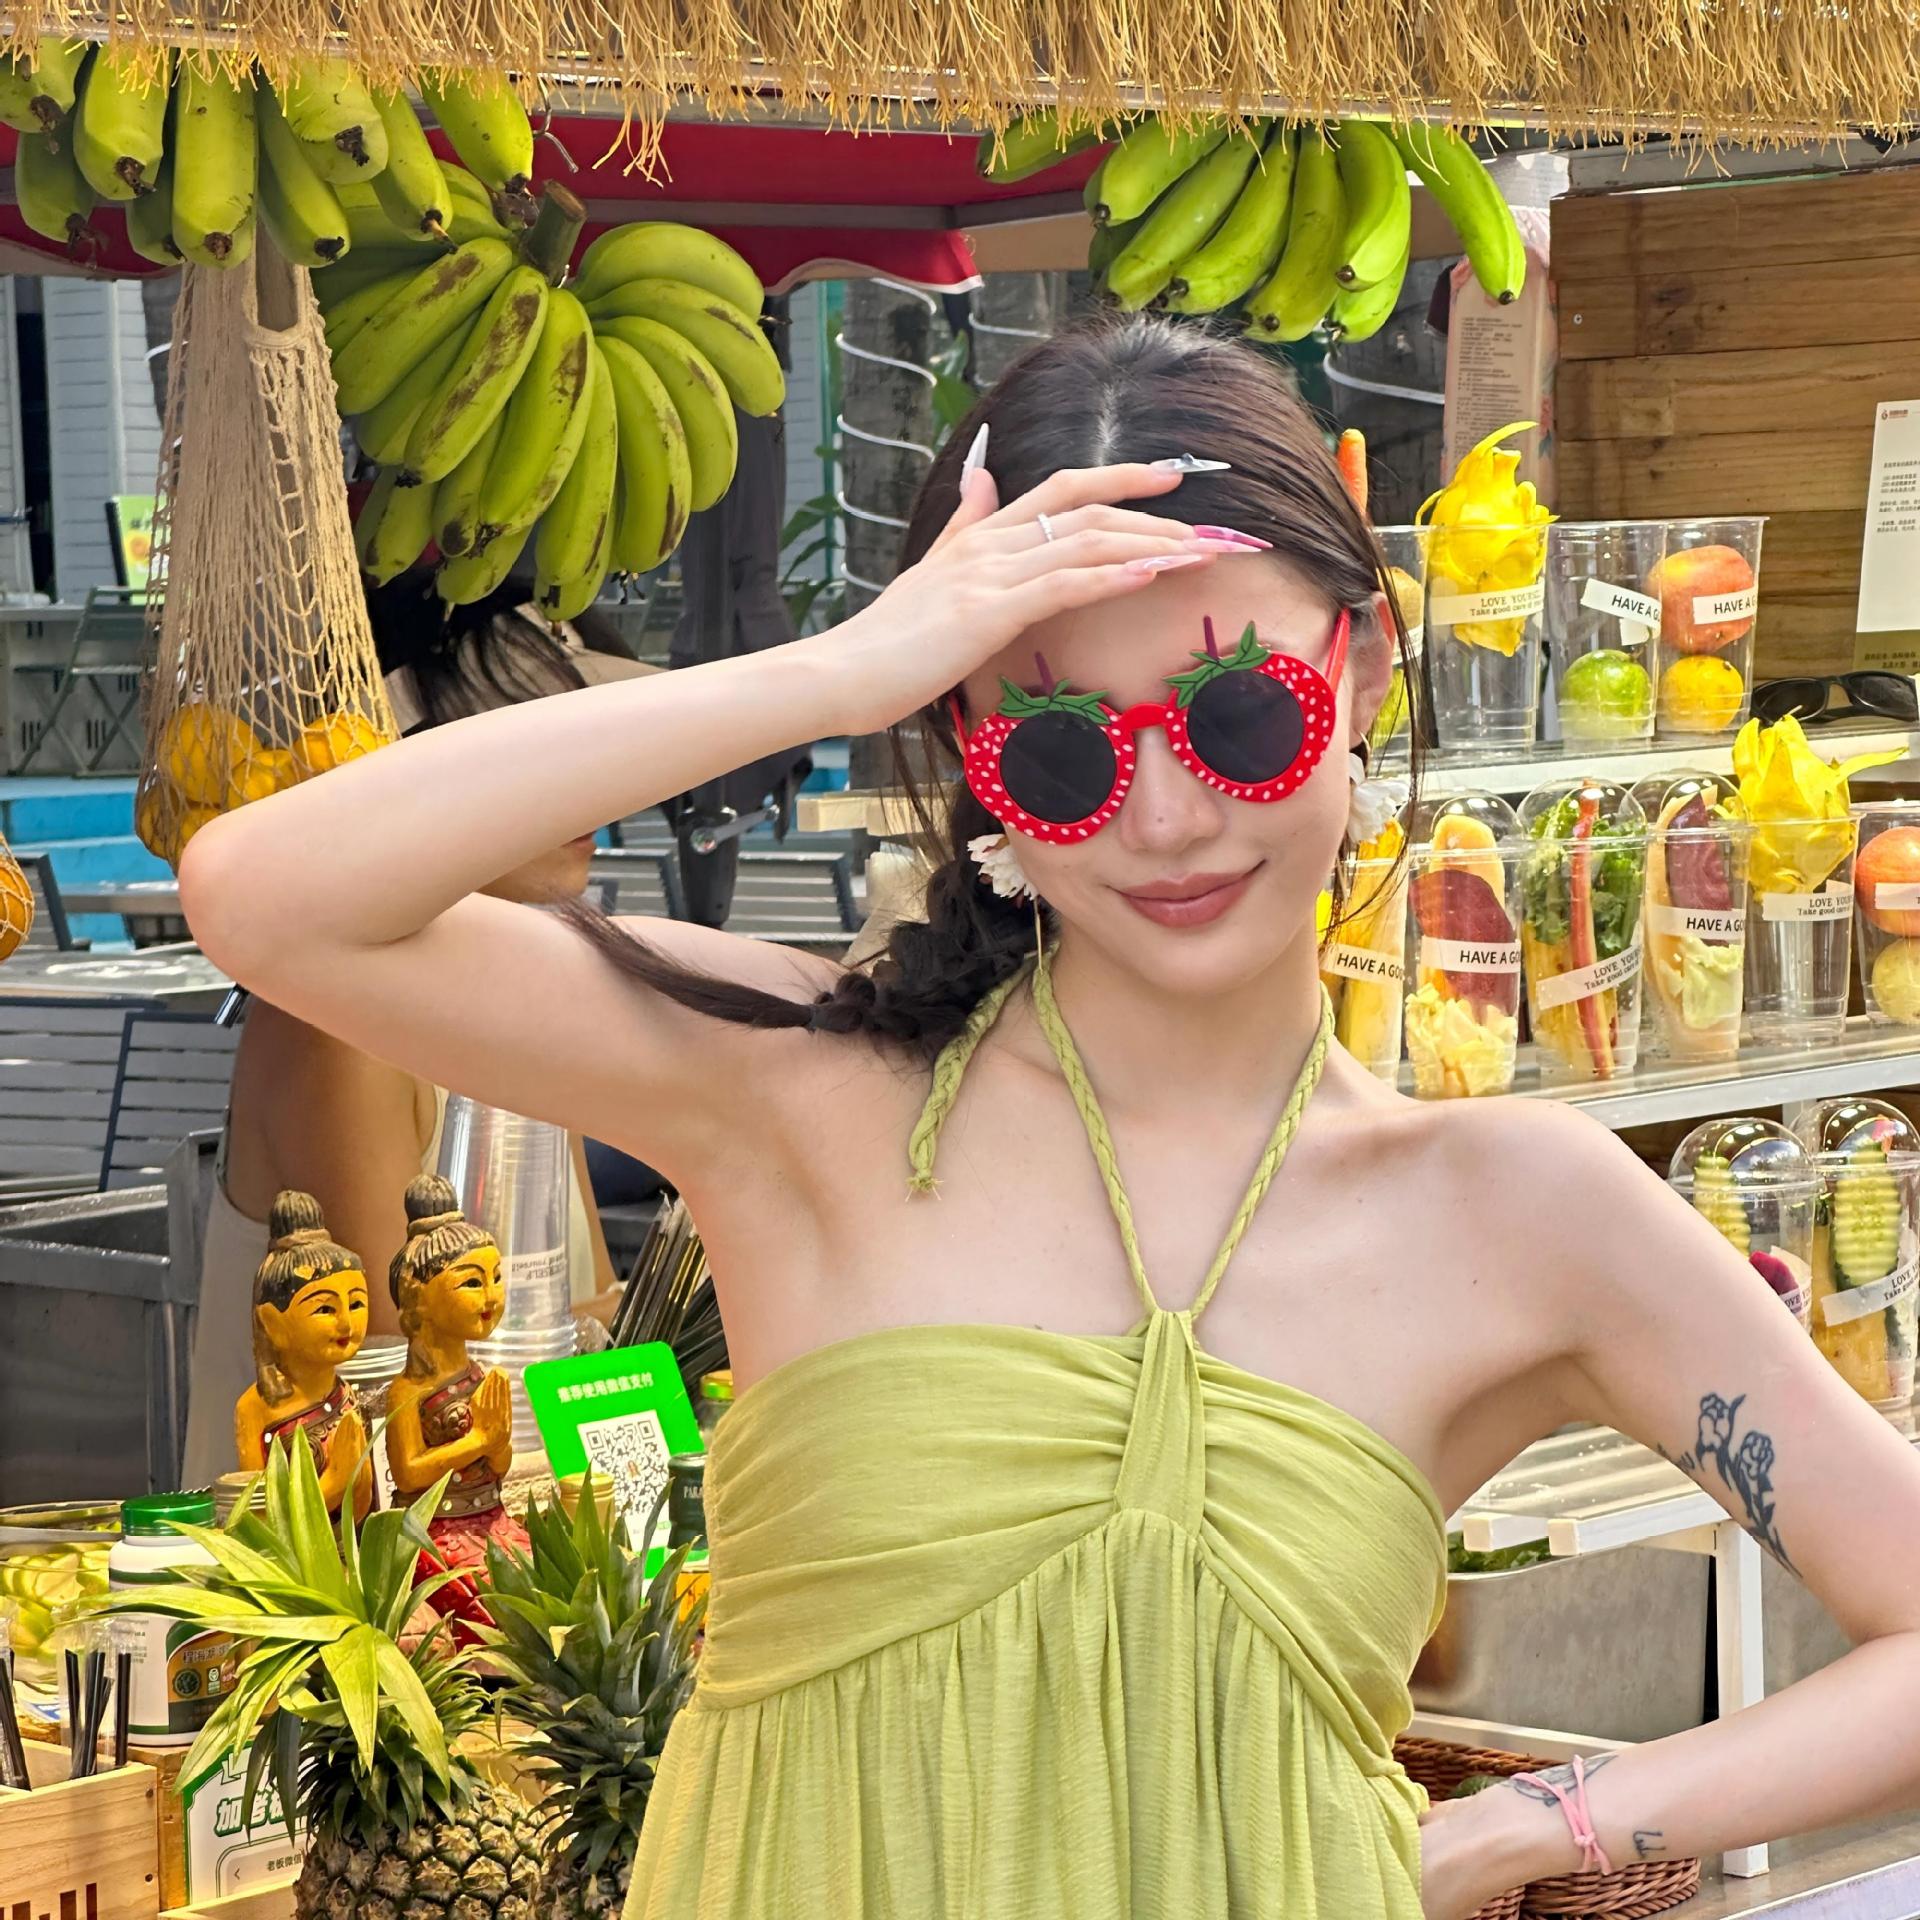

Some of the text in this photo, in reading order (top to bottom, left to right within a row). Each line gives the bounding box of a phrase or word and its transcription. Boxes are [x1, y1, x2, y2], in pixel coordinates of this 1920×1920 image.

[1481, 596, 1507, 608] LOVE
[1612, 594, 1644, 615] HAVE
[1645, 606, 1652, 616] A
[1714, 599, 1743, 615] HAVE
[1745, 597, 1751, 608] A
[1470, 608, 1490, 617] Take
[1493, 604, 1511, 615] good
[1809, 897, 1833, 908] LOVE
[1798, 908, 1816, 916] Take
[1819, 907, 1836, 916] good
[1686, 917, 1744, 932] HAVE A GO
[1336, 952, 1377, 973] HAVE
[1377, 963, 1386, 975] A
[1460, 949, 1521, 965] HAVE A GO
[1593, 961, 1618, 979] LOVE
[1584, 977, 1605, 990] Take
[1891, 1271, 1911, 1289] LOVE
[1884, 1287, 1899, 1301] Take
[1784, 1295, 1801, 1308] OVE
